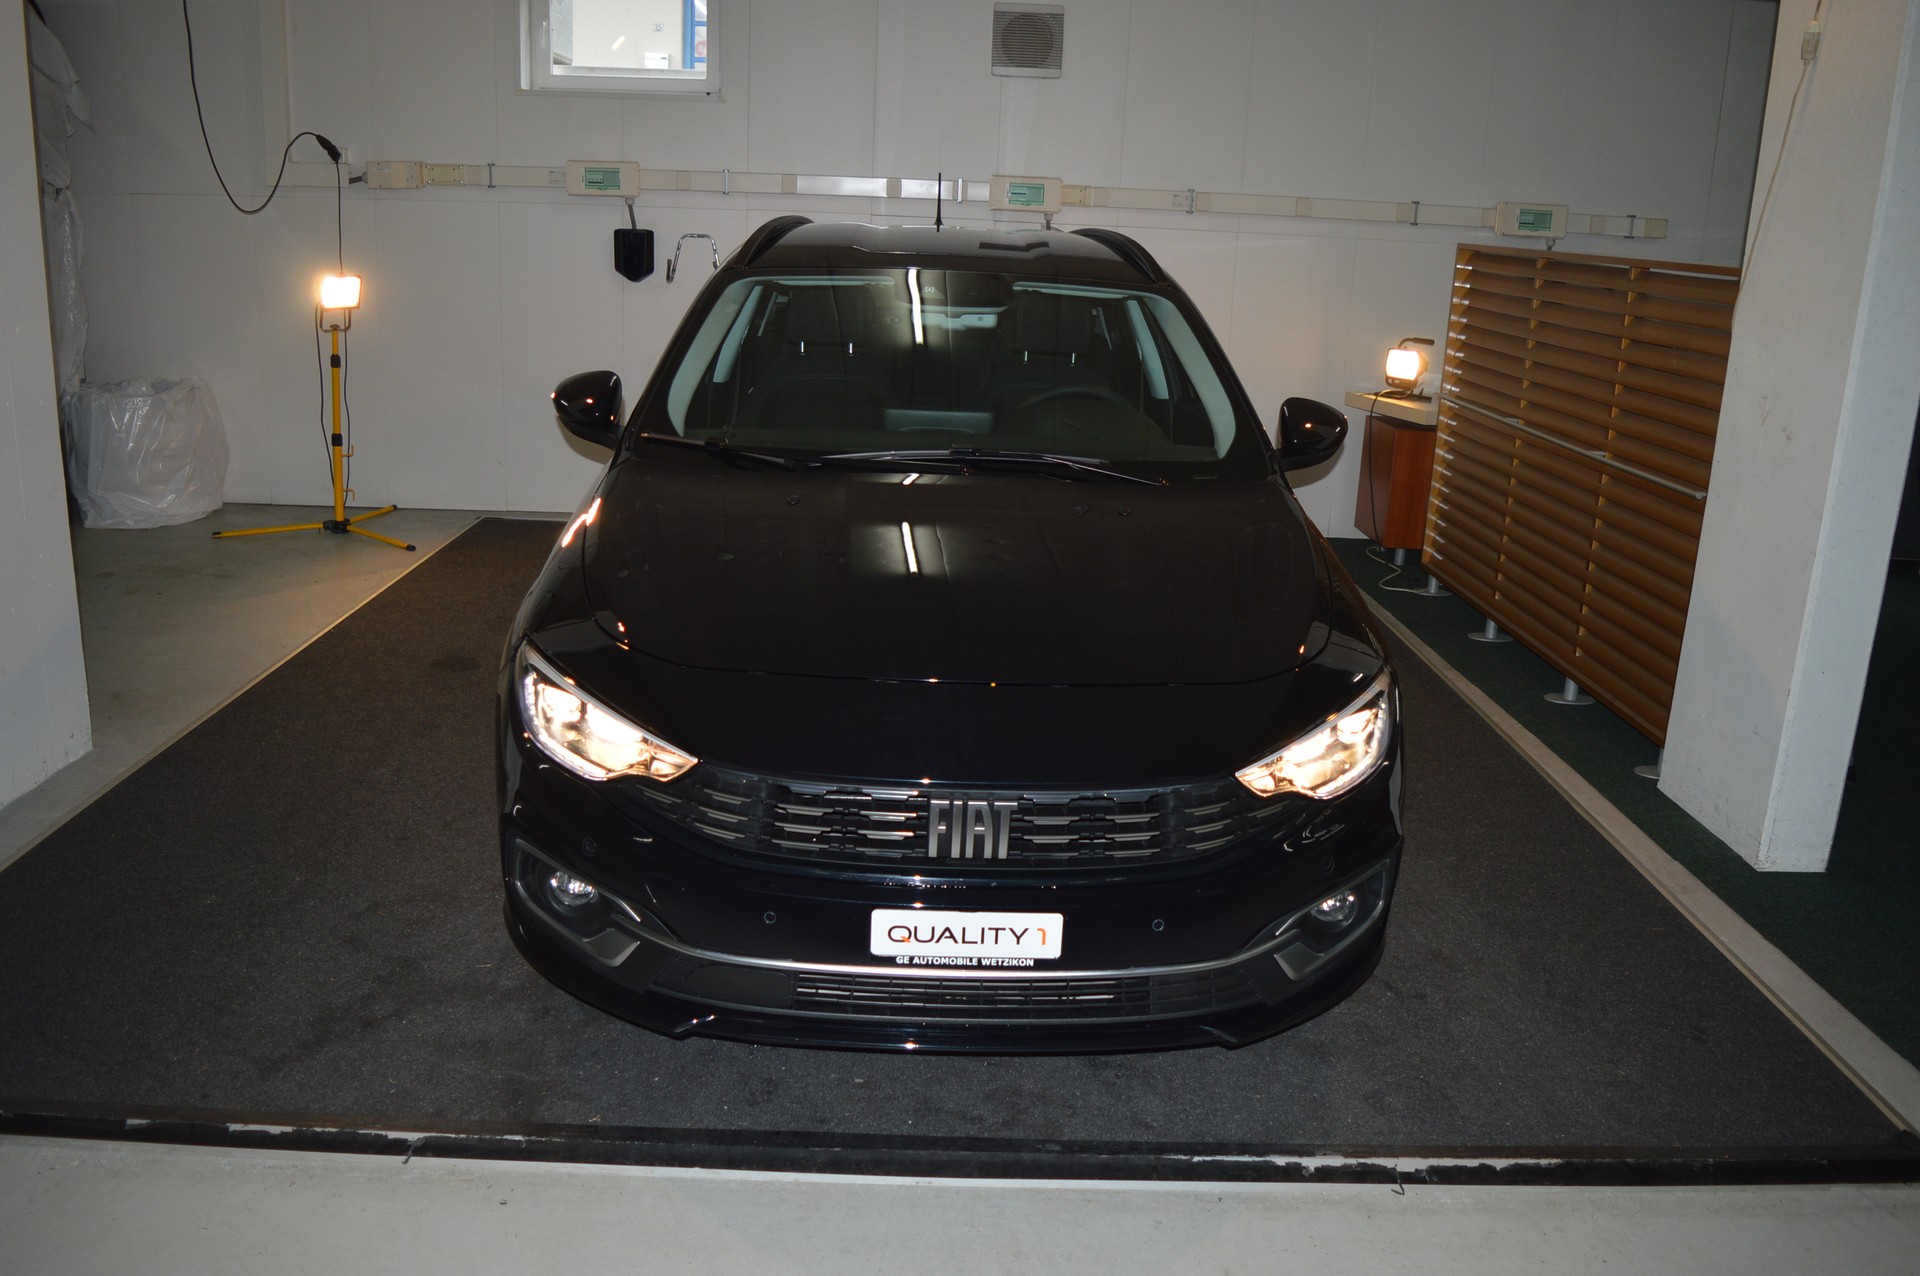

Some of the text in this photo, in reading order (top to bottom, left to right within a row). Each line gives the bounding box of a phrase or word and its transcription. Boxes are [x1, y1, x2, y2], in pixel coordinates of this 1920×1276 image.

[928, 800, 1018, 859] FIAT
[896, 956, 1034, 967] GE AUTOMOBILE WETZIKON
